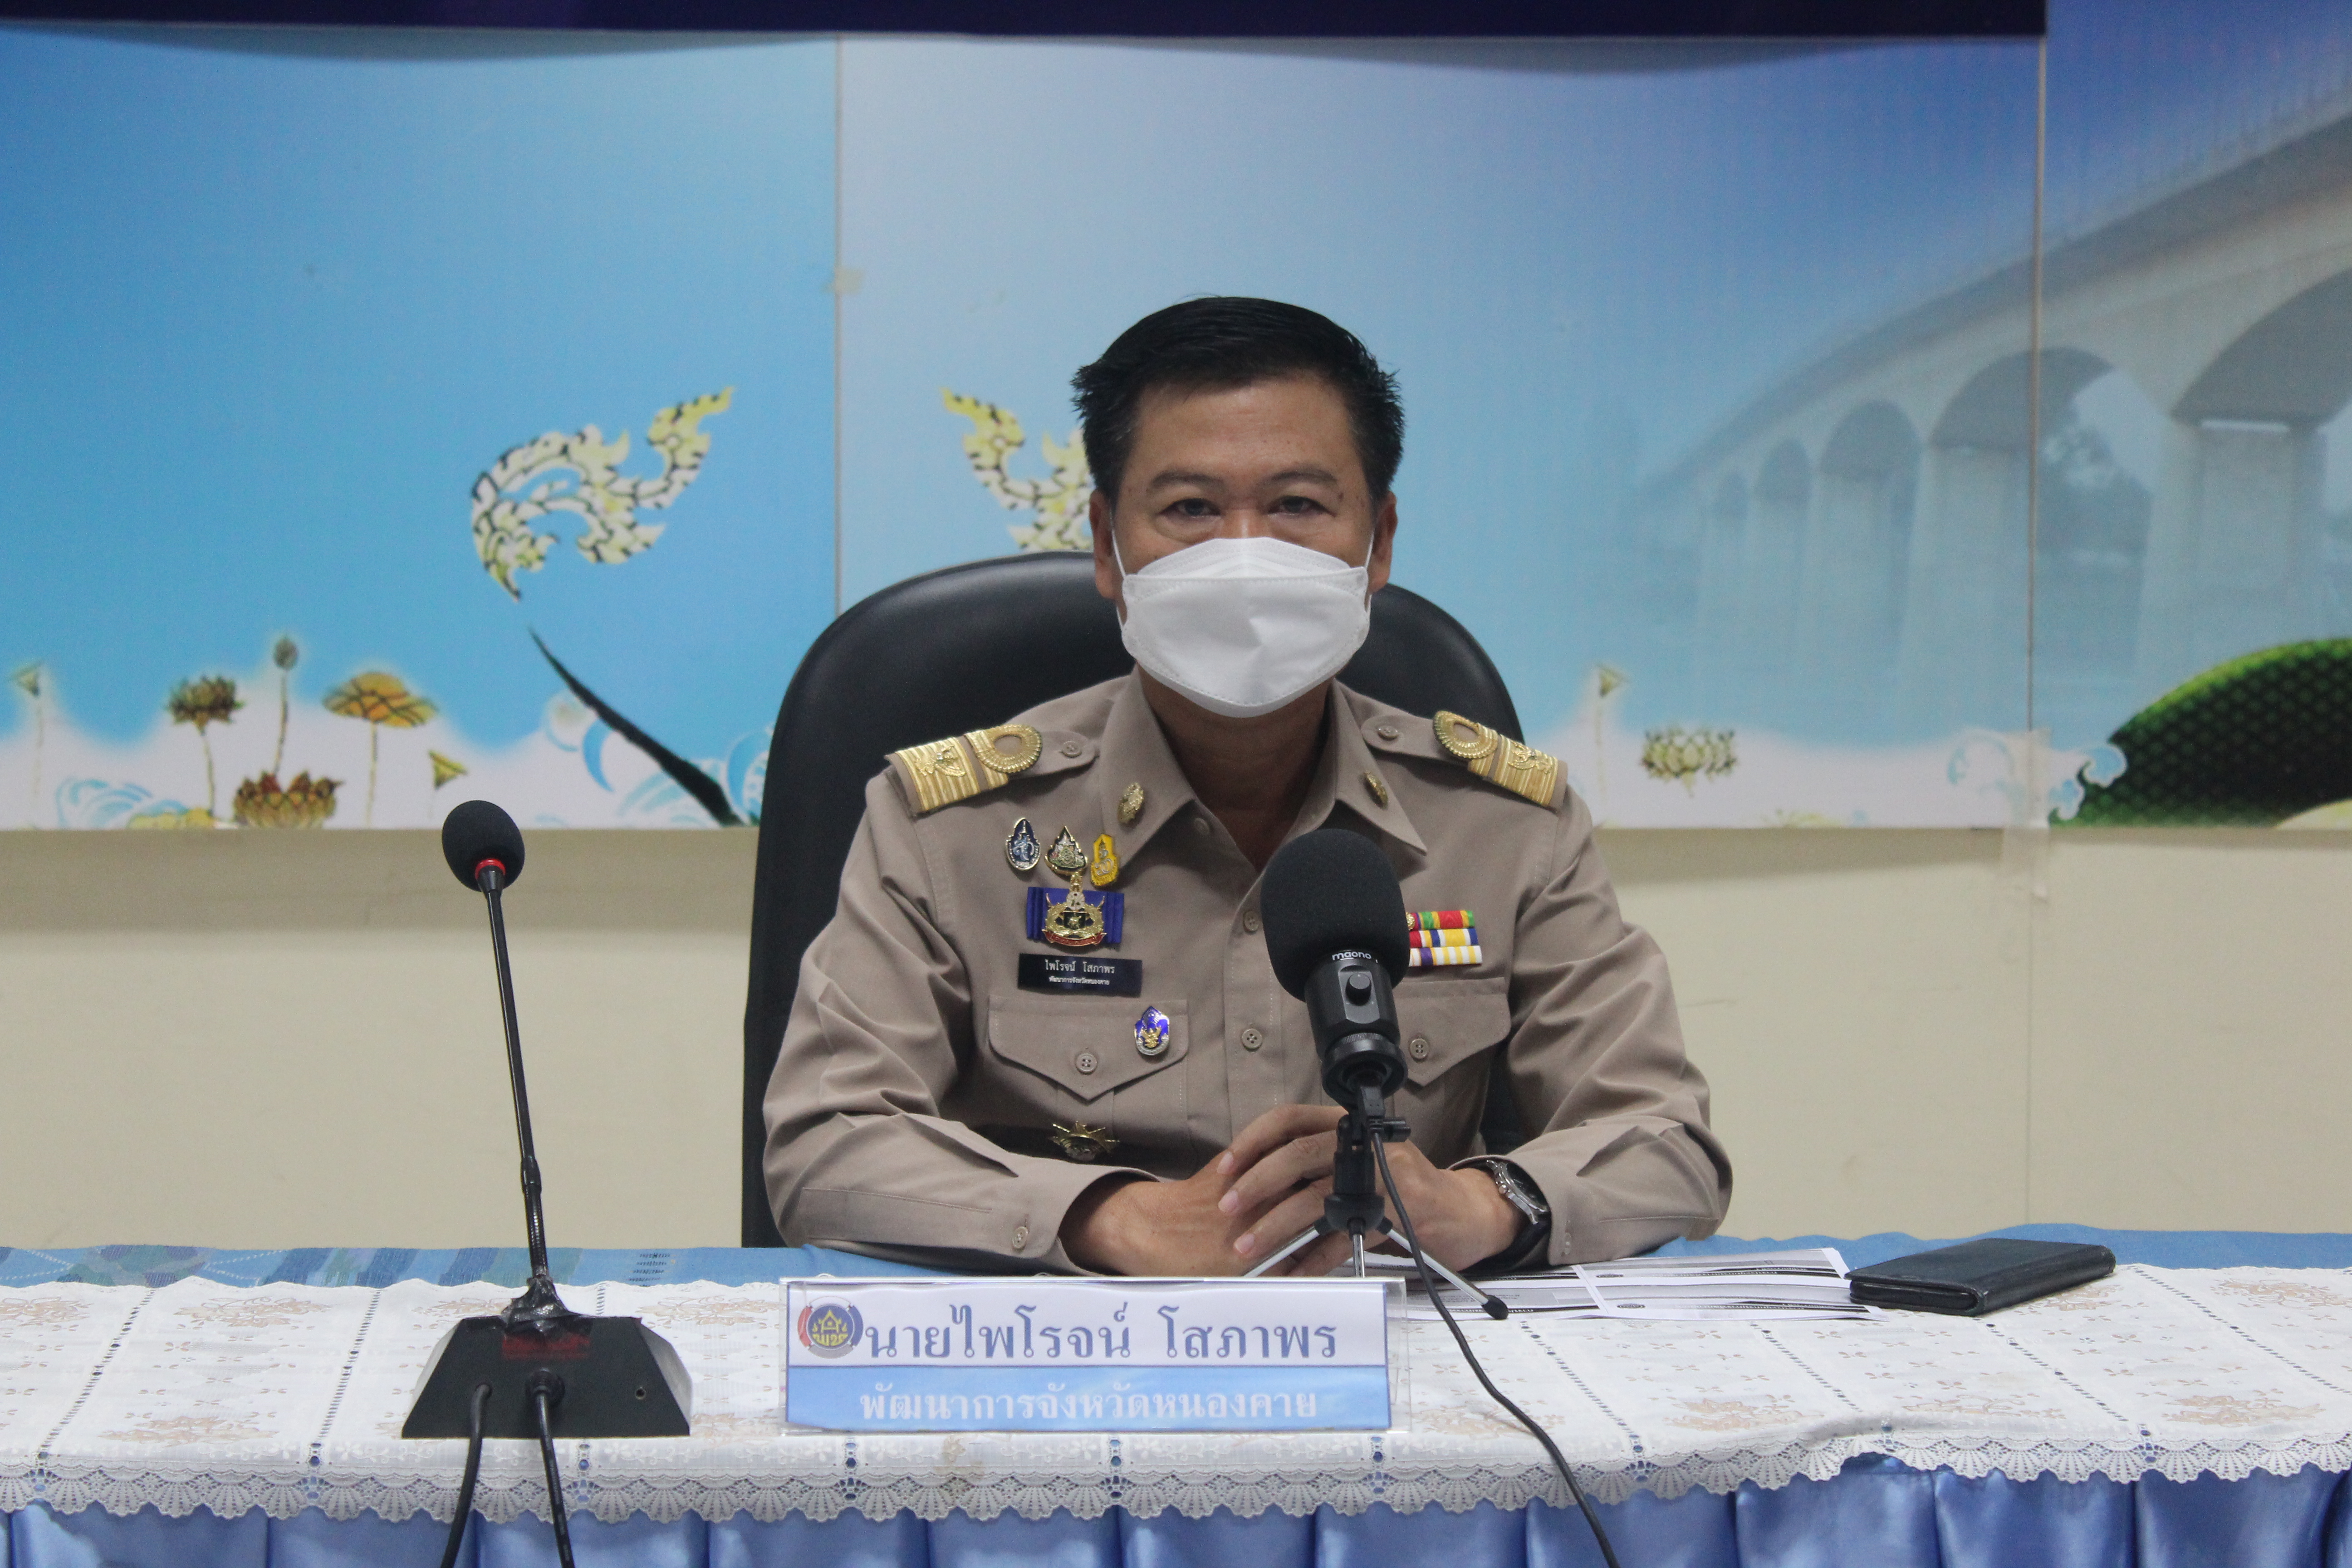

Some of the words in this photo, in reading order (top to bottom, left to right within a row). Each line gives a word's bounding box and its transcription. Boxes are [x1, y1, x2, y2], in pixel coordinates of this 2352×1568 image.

[1044, 959, 1076, 971] ไพโรจน์
[1083, 961, 1115, 974] โสภาพร
[1332, 951, 1372, 961] maono
[865, 1302, 1131, 1358] นายไพโรจน์
[1157, 1305, 1337, 1358] โสภาพร
[860, 1382, 1317, 1420] พัฒนาการจังหวัดหนองคาย
